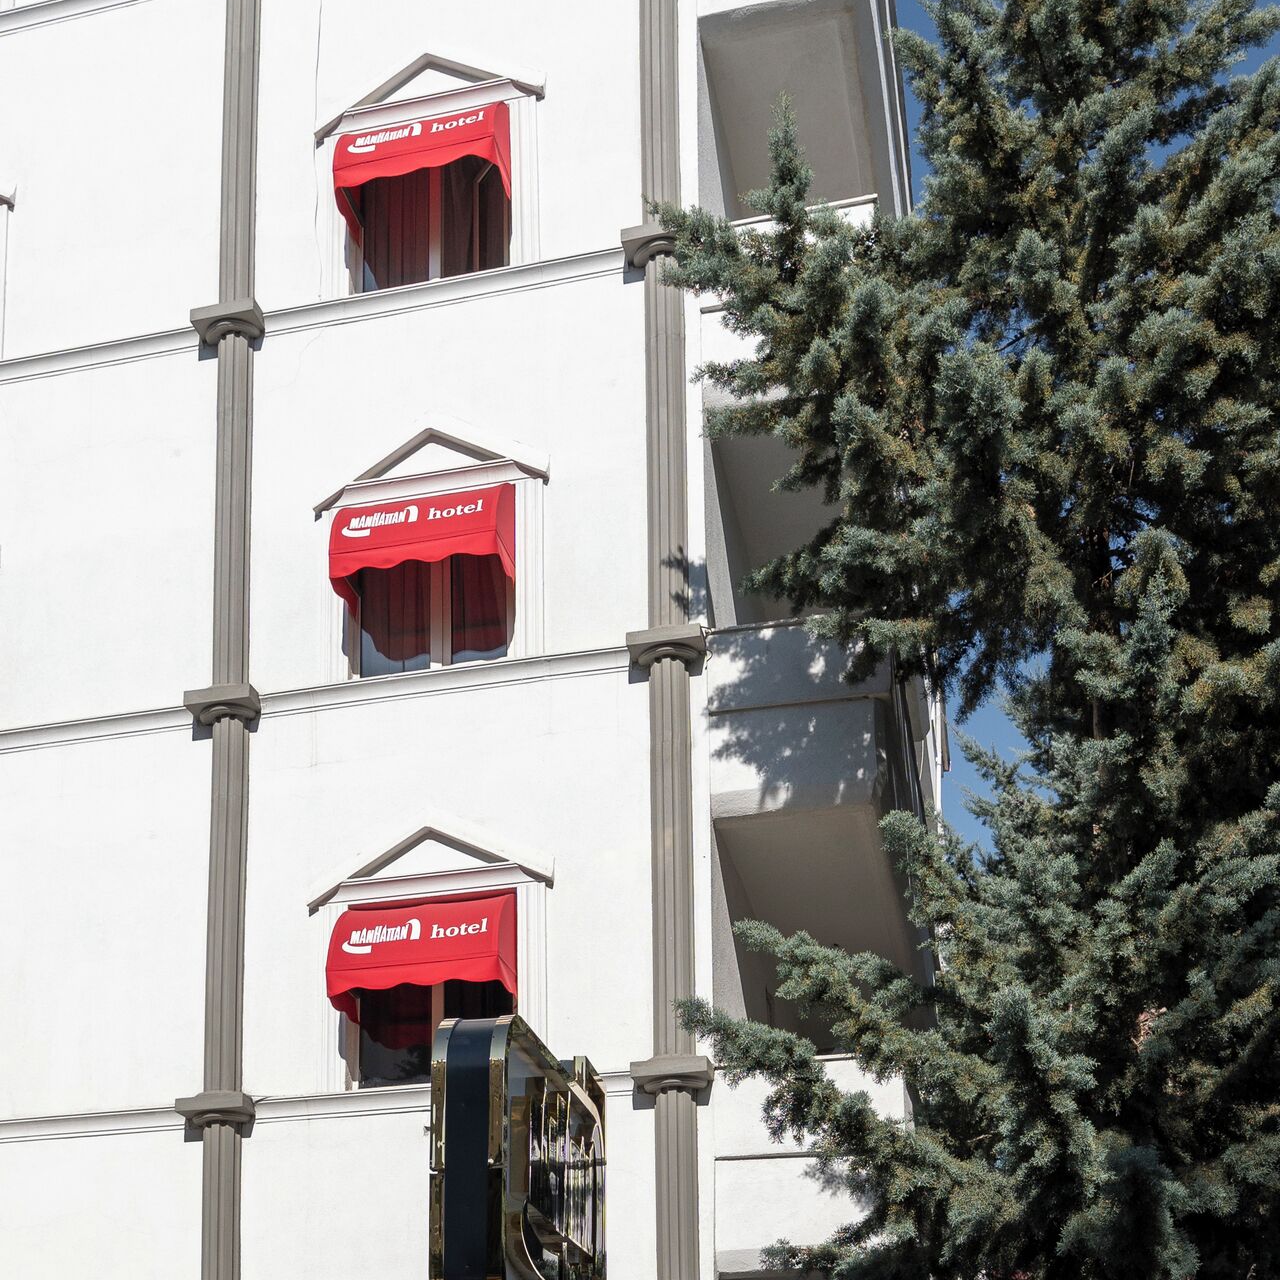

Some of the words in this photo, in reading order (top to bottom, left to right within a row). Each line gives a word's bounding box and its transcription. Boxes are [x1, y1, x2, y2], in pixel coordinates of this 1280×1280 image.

[430, 111, 484, 133] hotel
[427, 499, 483, 520] hotel
[349, 919, 421, 945] MANHATTAN
[430, 918, 487, 939] hotel
